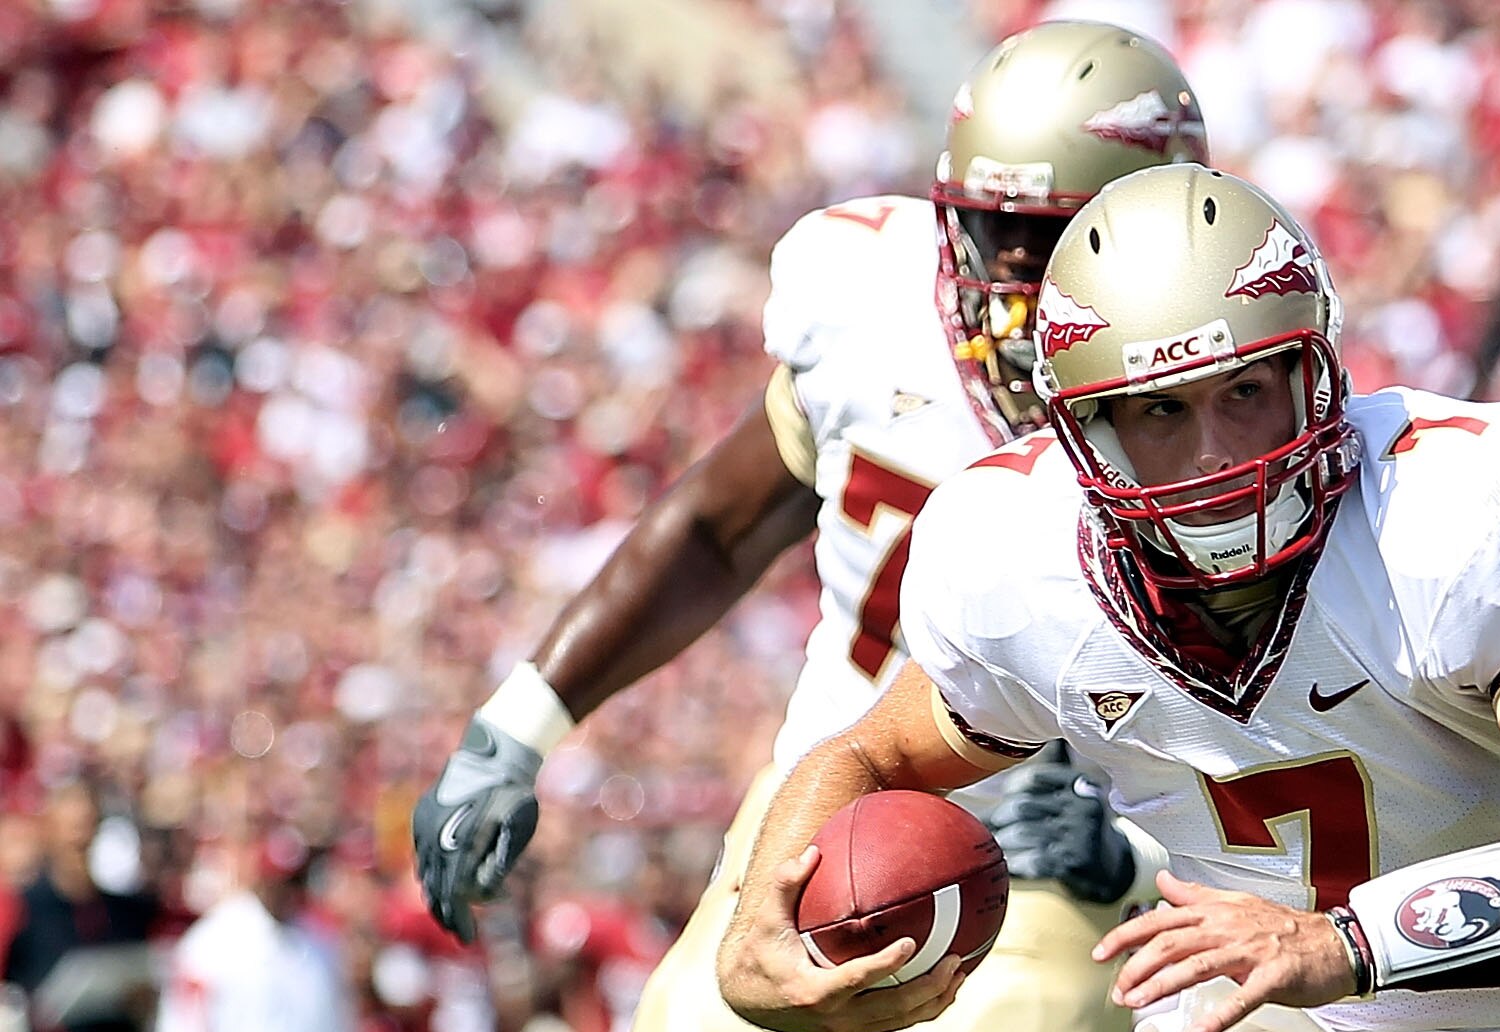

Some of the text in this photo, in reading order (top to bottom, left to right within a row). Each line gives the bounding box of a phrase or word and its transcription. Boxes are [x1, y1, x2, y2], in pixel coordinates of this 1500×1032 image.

[1150, 336, 1200, 367] ACC
[961, 437, 1057, 475] 7
[1378, 416, 1489, 461] 7
[840, 443, 942, 688] 7
[1210, 543, 1251, 560] Riddell
[1103, 701, 1124, 714] ACC
[1194, 749, 1380, 913] 7
